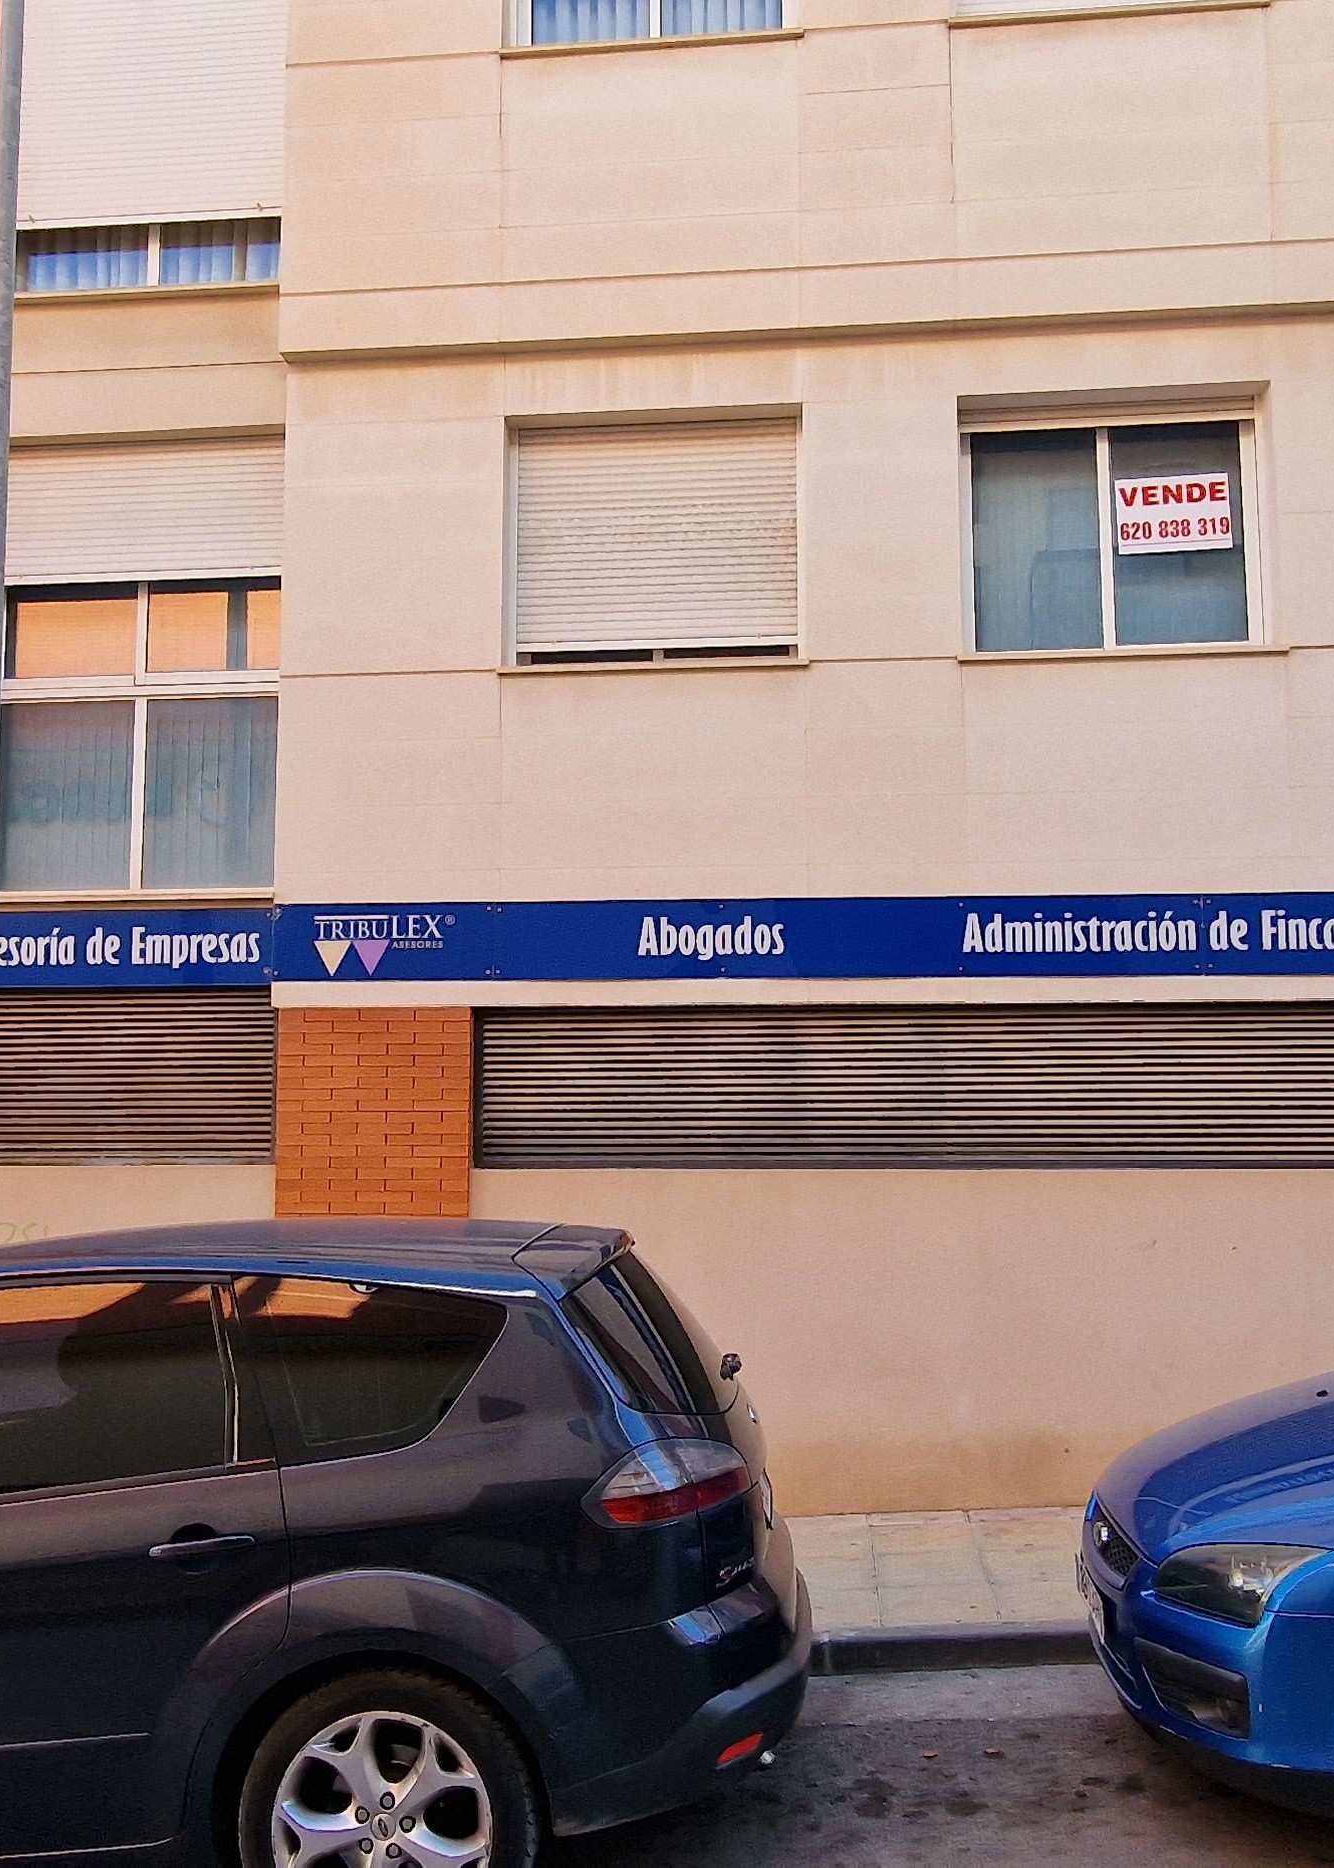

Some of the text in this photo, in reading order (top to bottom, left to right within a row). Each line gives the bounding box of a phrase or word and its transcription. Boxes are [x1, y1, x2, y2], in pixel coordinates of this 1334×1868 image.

[1118, 481, 1227, 507] VENDE
[1120, 517, 1230, 541] 620 838 319
[86, 927, 121, 965] de
[131, 926, 261, 969] Empresas
[392, 940, 445, 949] ASESORES
[637, 915, 785, 961] Abogados
[962, 910, 1198, 954] Administración
[1209, 910, 1249, 951] de
